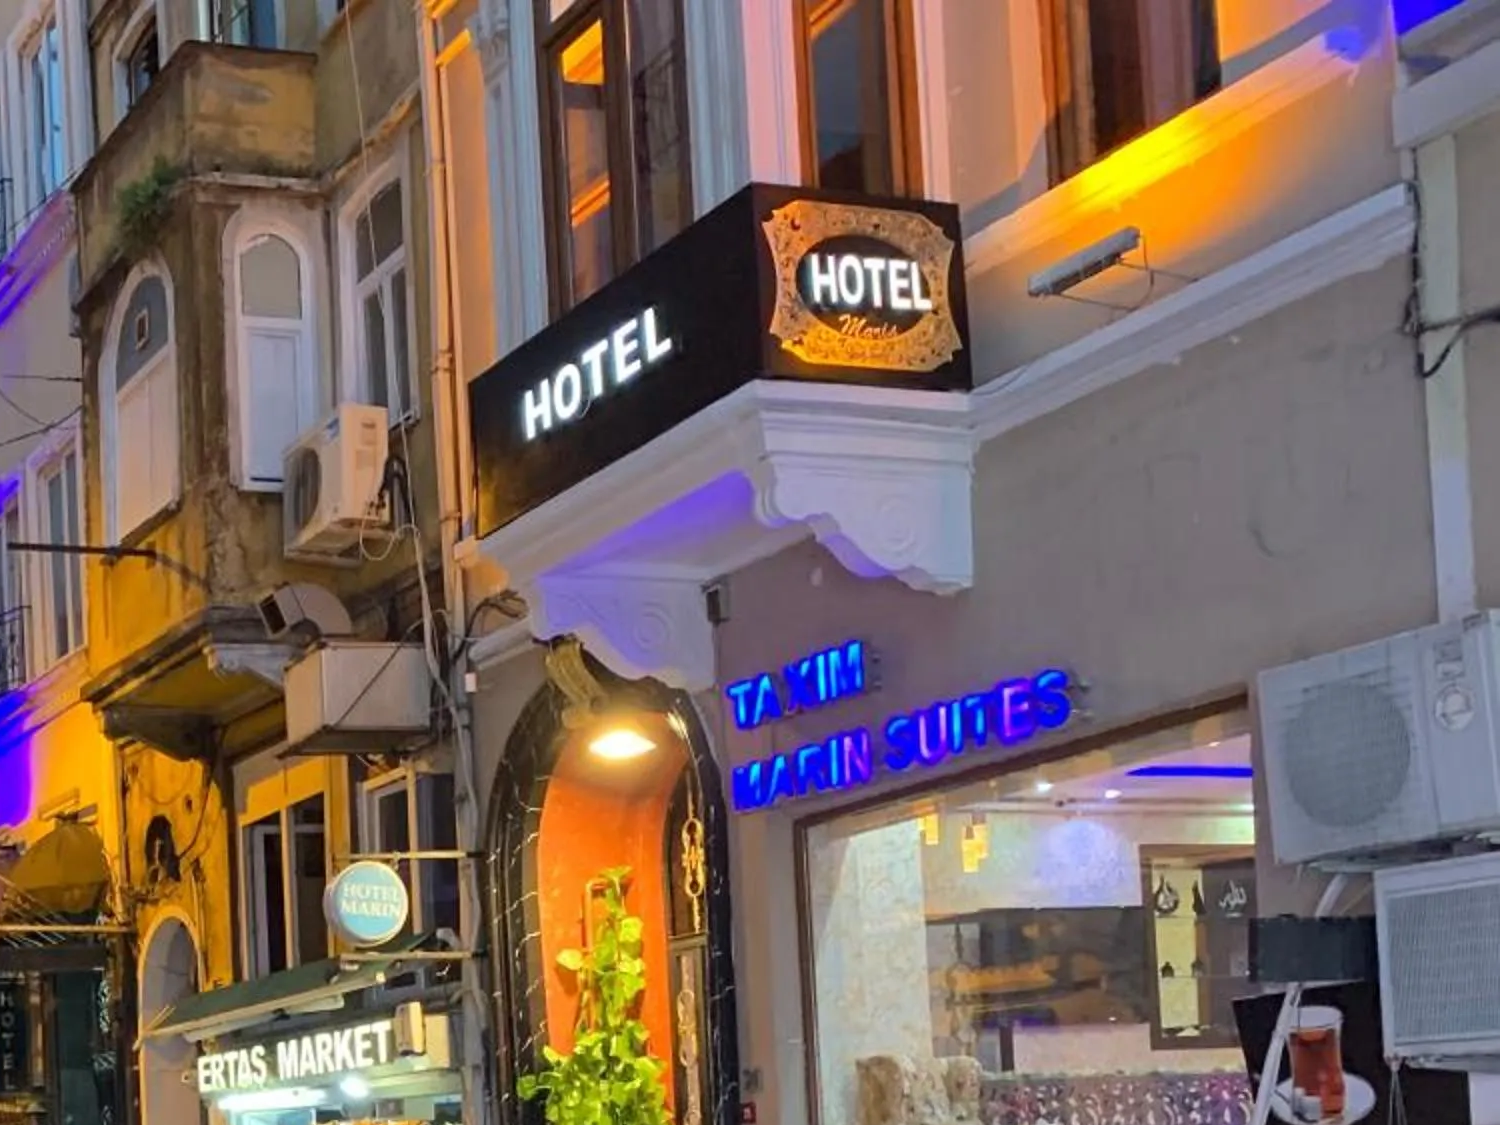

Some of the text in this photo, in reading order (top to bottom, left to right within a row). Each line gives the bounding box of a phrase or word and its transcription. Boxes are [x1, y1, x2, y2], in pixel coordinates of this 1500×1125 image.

[810, 253, 933, 310] HOTEL
[522, 307, 672, 441] HOTEL
[726, 640, 864, 729] TAXIM
[732, 670, 1071, 811] MARIN SUITES
[342, 882, 400, 904] HOTEL
[0, 991, 16, 1090] HOTEL
[277, 1019, 391, 1080] MARKET
